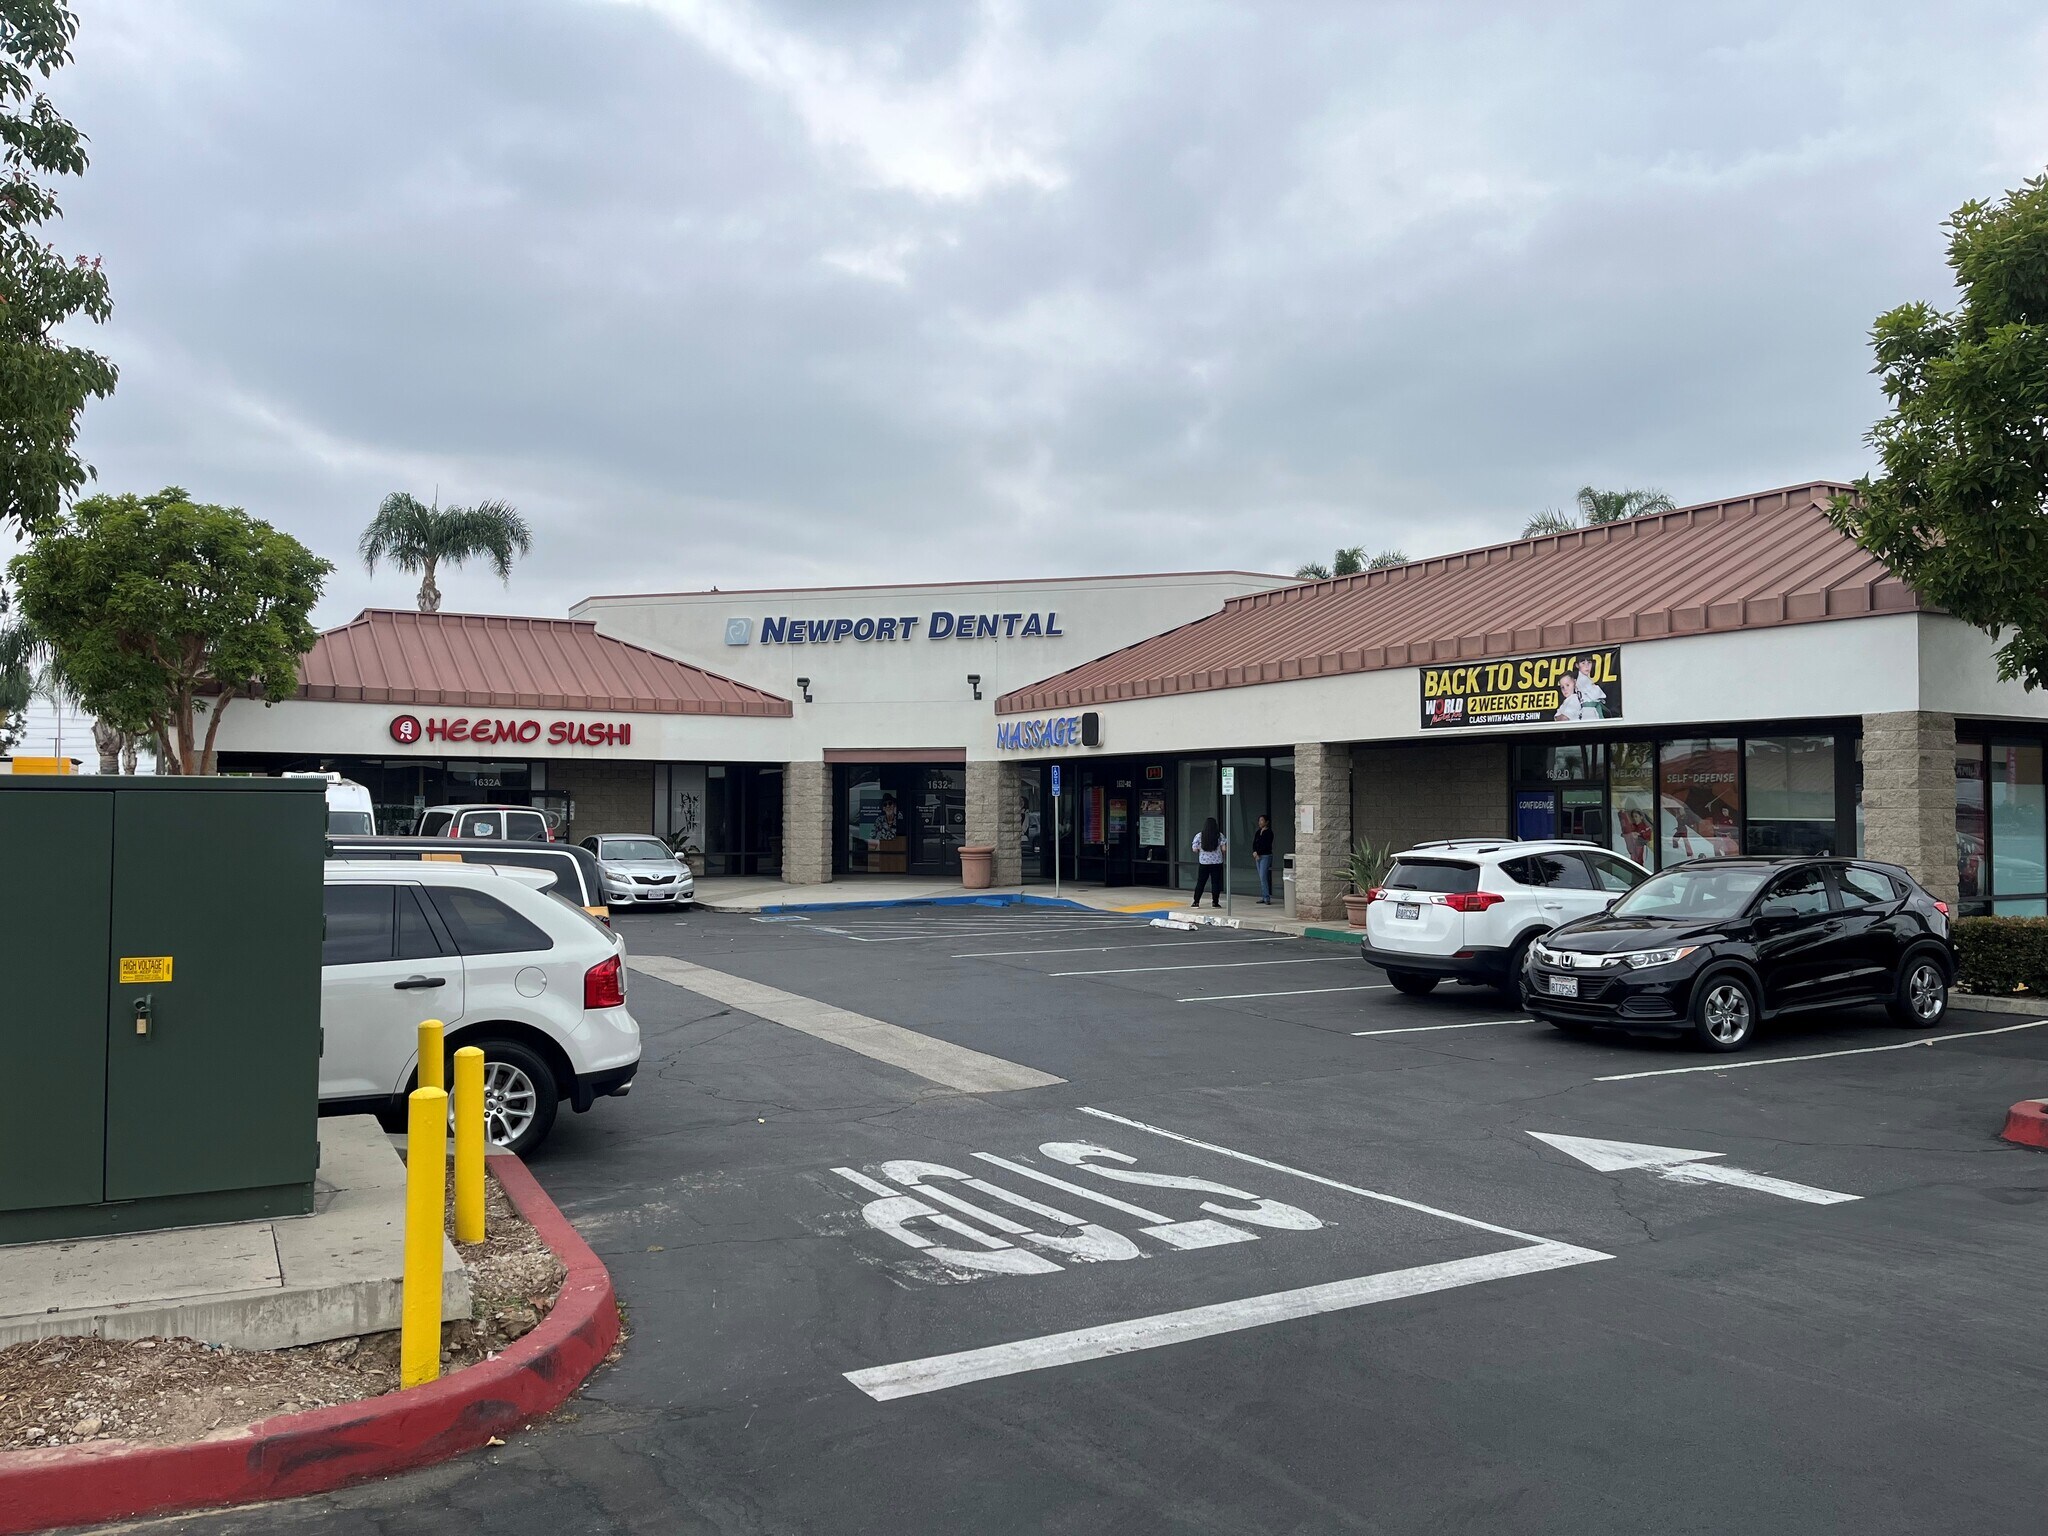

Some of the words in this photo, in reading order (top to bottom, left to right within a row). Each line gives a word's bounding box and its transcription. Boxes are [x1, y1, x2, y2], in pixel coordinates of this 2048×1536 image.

[760, 616, 918, 644] NEWPORT
[928, 611, 1063, 639] DENTAL
[1425, 667, 1482, 697] BACK
[1485, 662, 1514, 691] TO
[1425, 698, 1464, 716] WORLD
[1470, 699, 1478, 712] 2
[1478, 694, 1519, 711] WEEKS
[1520, 692, 1555, 709] FREE!
[1469, 714, 1487, 724] CLASS
[1487, 713, 1502, 723] WITH
[1502, 712, 1525, 722] MASTER
[1525, 711, 1541, 721] SHIN
[426, 718, 541, 744] HEEMO
[548, 721, 631, 746] SUSHI
[996, 716, 1080, 750] MASSAGE
[1613, 767, 1653, 778] WELCOME
[1667, 772, 1735, 783] SELF-DEFENSE
[473, 778, 501, 787] 1632A
[1519, 800, 1555, 810] CONFIDENCE
[123, 960, 137, 970] HIGH
[138, 960, 162, 970] VOLTAGE
[1551, 982, 1576, 995] 8TZP545
